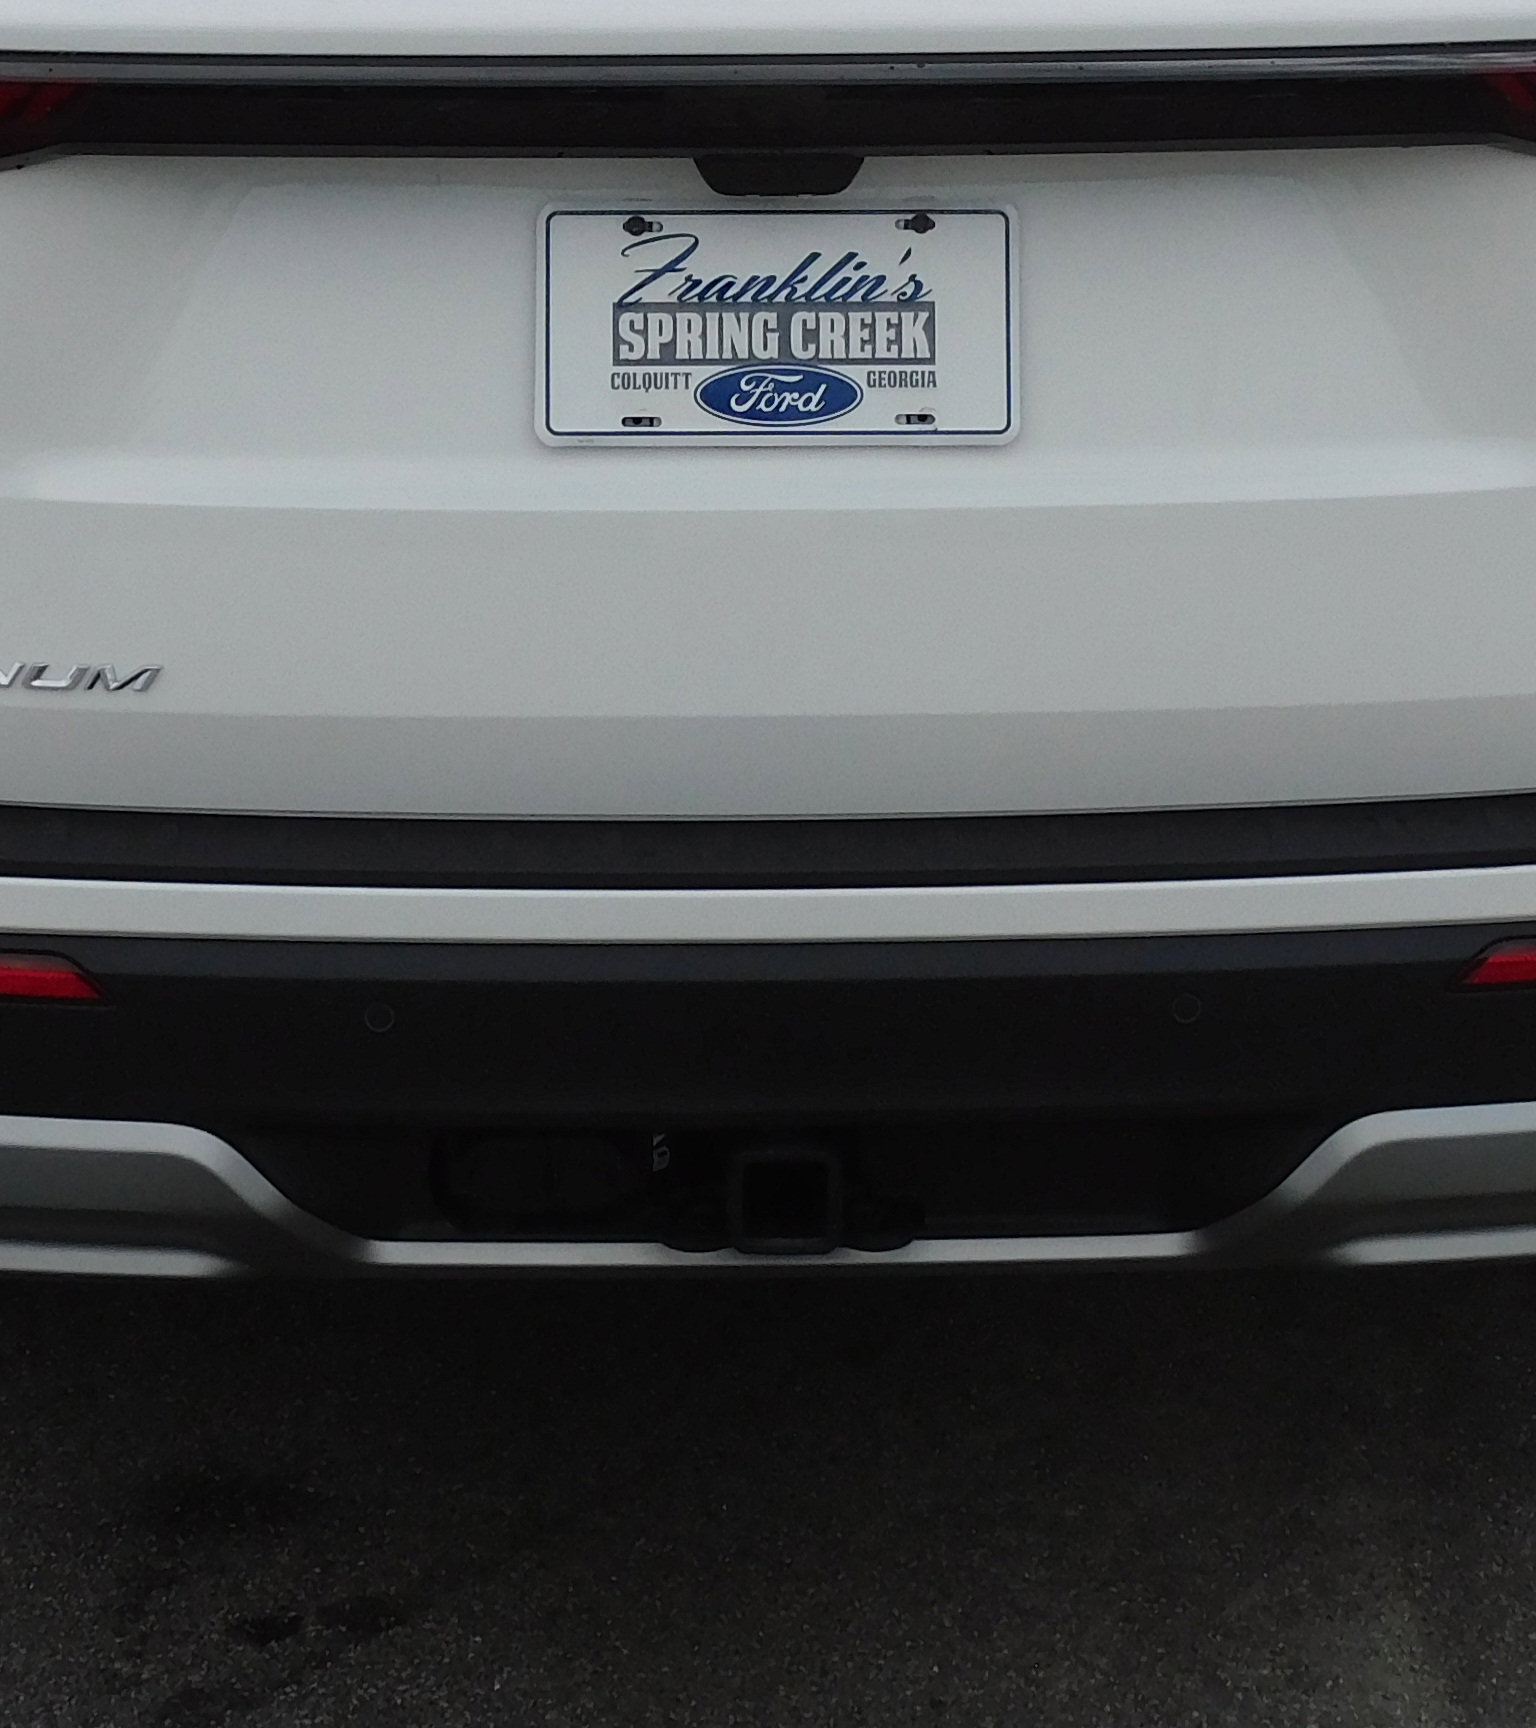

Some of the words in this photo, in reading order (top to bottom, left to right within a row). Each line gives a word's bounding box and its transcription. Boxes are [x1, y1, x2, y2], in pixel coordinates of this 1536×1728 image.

[616, 232, 932, 309] Franklin's
[617, 310, 780, 361] SPRING
[789, 310, 931, 361] CREEK
[610, 372, 693, 392] COLQUITT
[729, 372, 826, 413] Ford
[866, 369, 938, 389] GEORGIA
